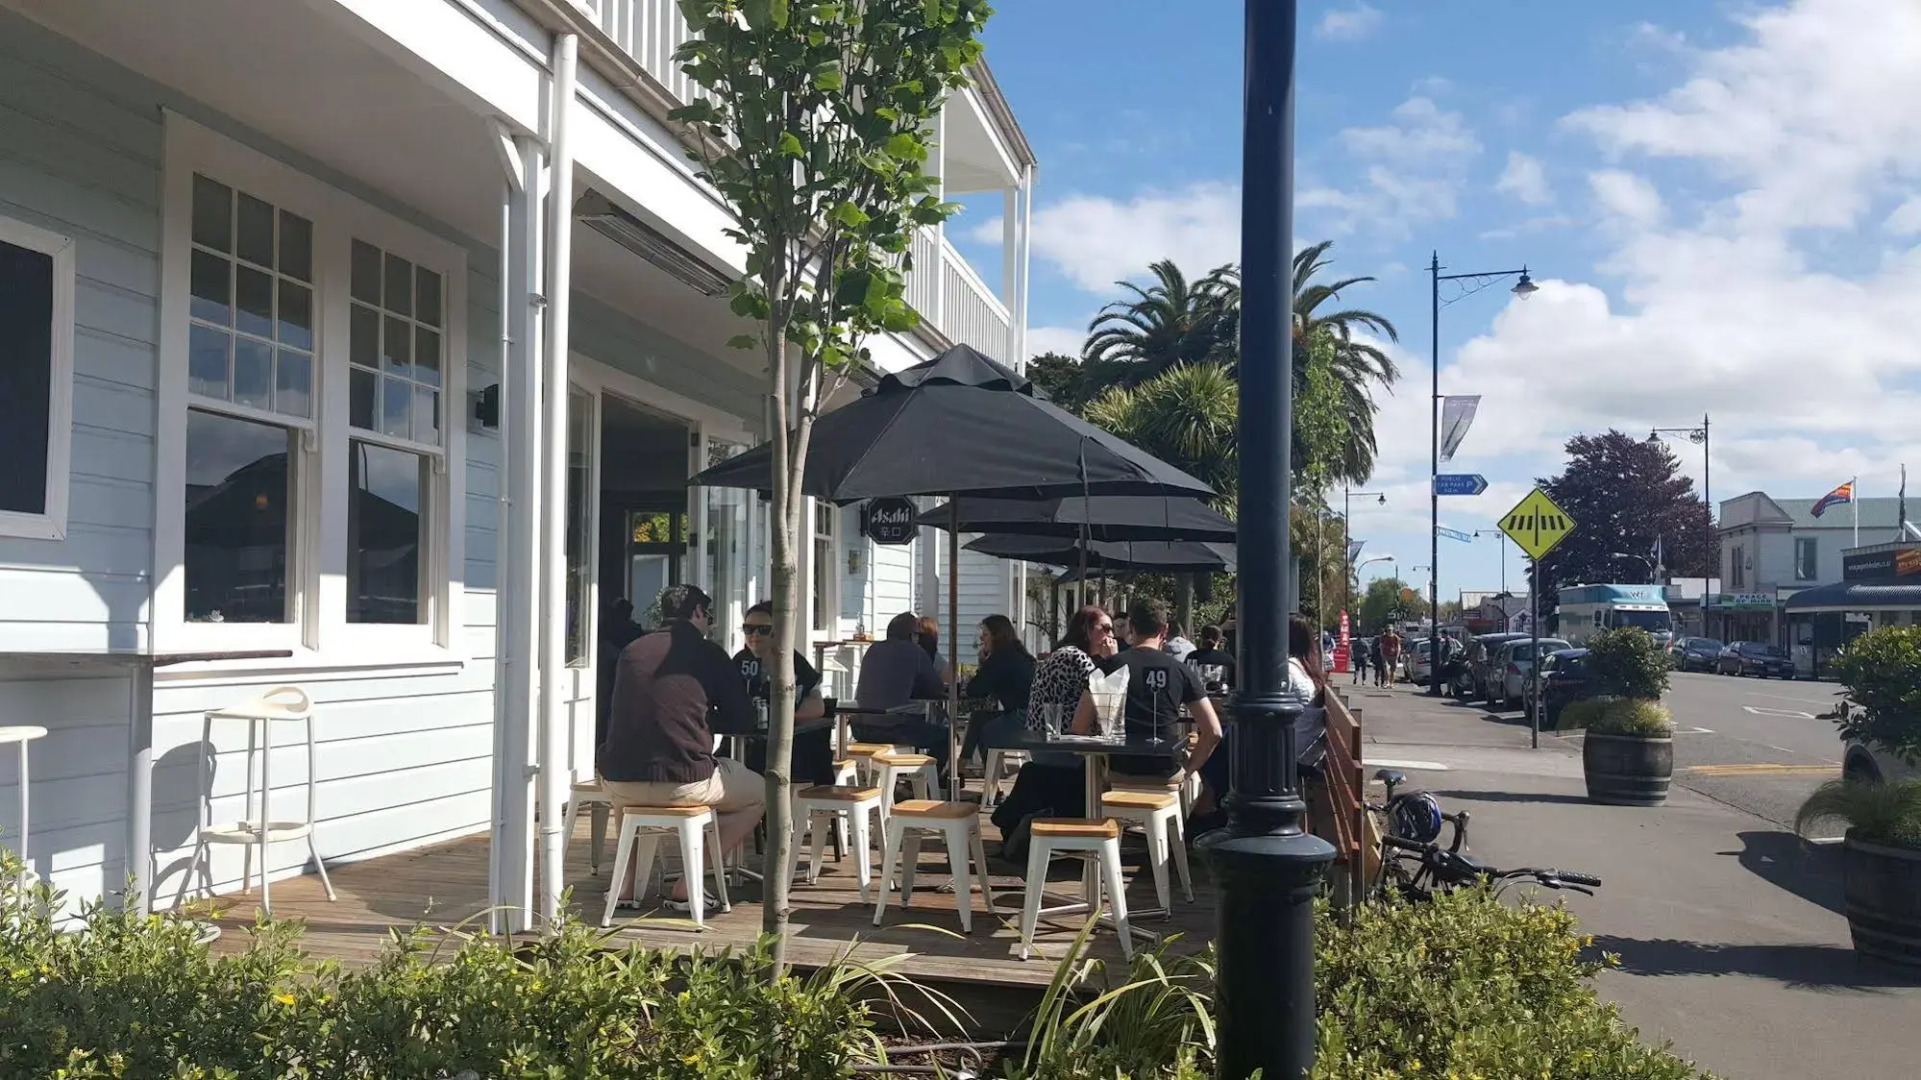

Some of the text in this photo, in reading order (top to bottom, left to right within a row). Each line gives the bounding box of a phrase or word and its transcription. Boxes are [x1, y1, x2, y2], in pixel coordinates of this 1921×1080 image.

[871, 507, 910, 523] Asahi
[741, 660, 759, 676] 50
[1146, 670, 1167, 688] 49
